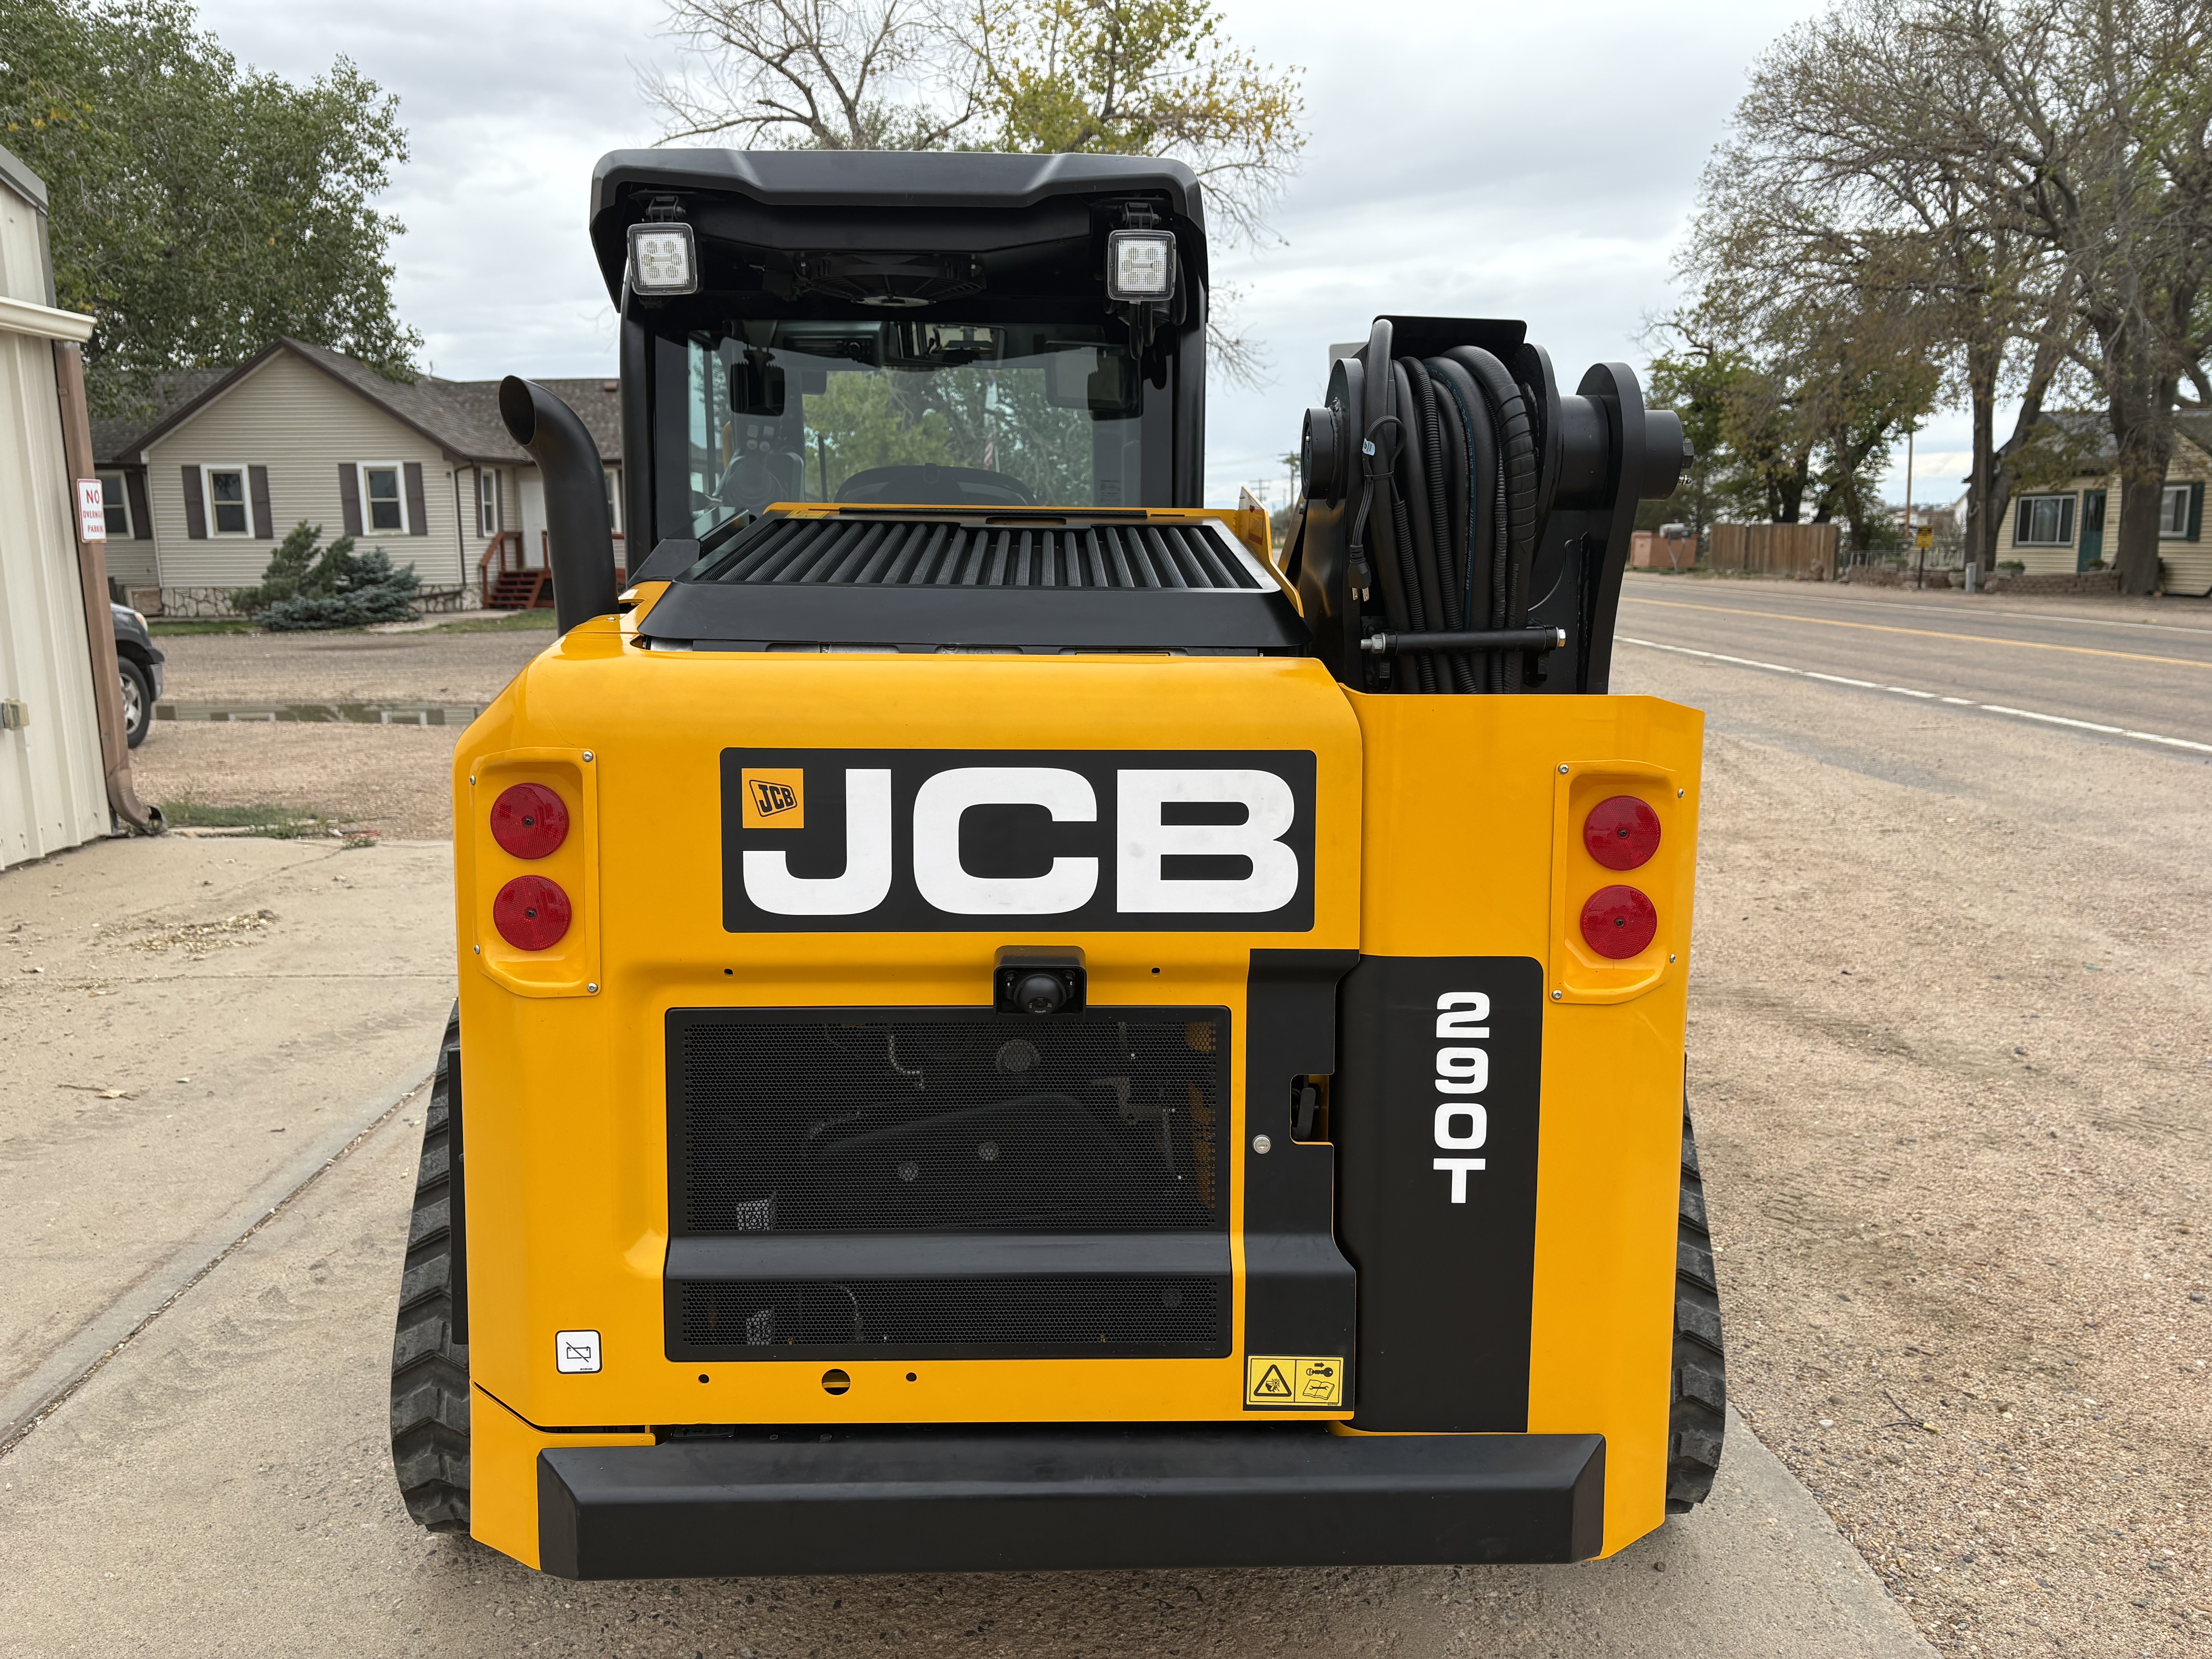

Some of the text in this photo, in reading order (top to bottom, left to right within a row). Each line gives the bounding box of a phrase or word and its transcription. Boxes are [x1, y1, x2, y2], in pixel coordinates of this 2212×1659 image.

[86, 489, 100, 504] NO
[742, 767, 1299, 915] JCB
[758, 784, 794, 812] JCB
[1433, 992, 1490, 1203] 290T
